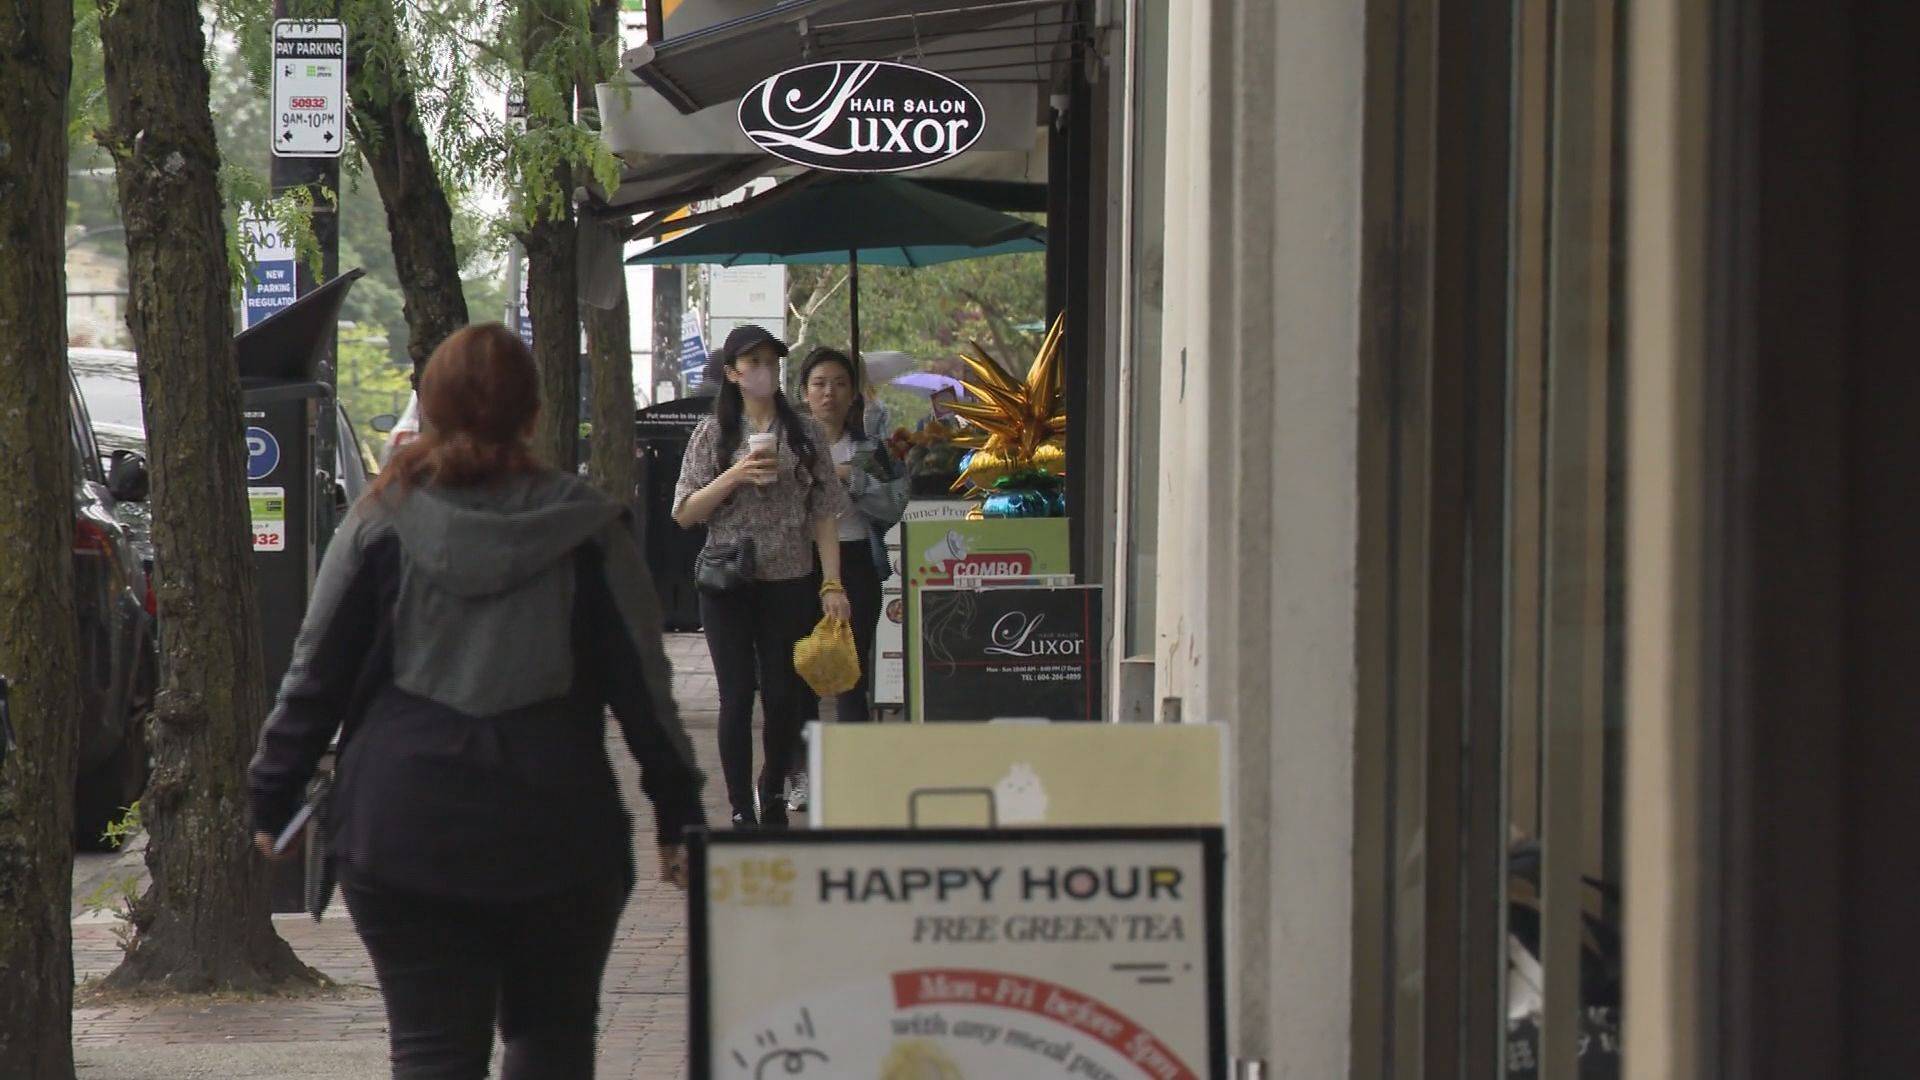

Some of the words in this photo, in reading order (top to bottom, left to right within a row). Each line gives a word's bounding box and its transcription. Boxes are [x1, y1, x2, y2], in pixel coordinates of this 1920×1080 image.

[276, 42, 295, 55] PAY
[297, 42, 341, 55] PARKING
[291, 98, 325, 108] 50932
[749, 62, 969, 156] Luxor
[850, 98, 894, 113] HAIR
[903, 99, 966, 114] SALON
[265, 269, 285, 279] NEW
[257, 283, 291, 293] PARKING
[952, 561, 1023, 577] COMBO
[983, 610, 1084, 657] Luxor
[818, 867, 1002, 903] HAPPY
[1021, 866, 1184, 901] HOUR
[912, 915, 998, 944] FREE
[1003, 914, 1119, 943] GREEN
[1120, 914, 1185, 942] TEA
[918, 974, 977, 1001] Mon
[994, 978, 1035, 1008] Fri
[1043, 990, 1124, 1039] before
[890, 1011, 947, 1036] with
[952, 1020, 1000, 1044] any
[1003, 1028, 1073, 1064] meal
